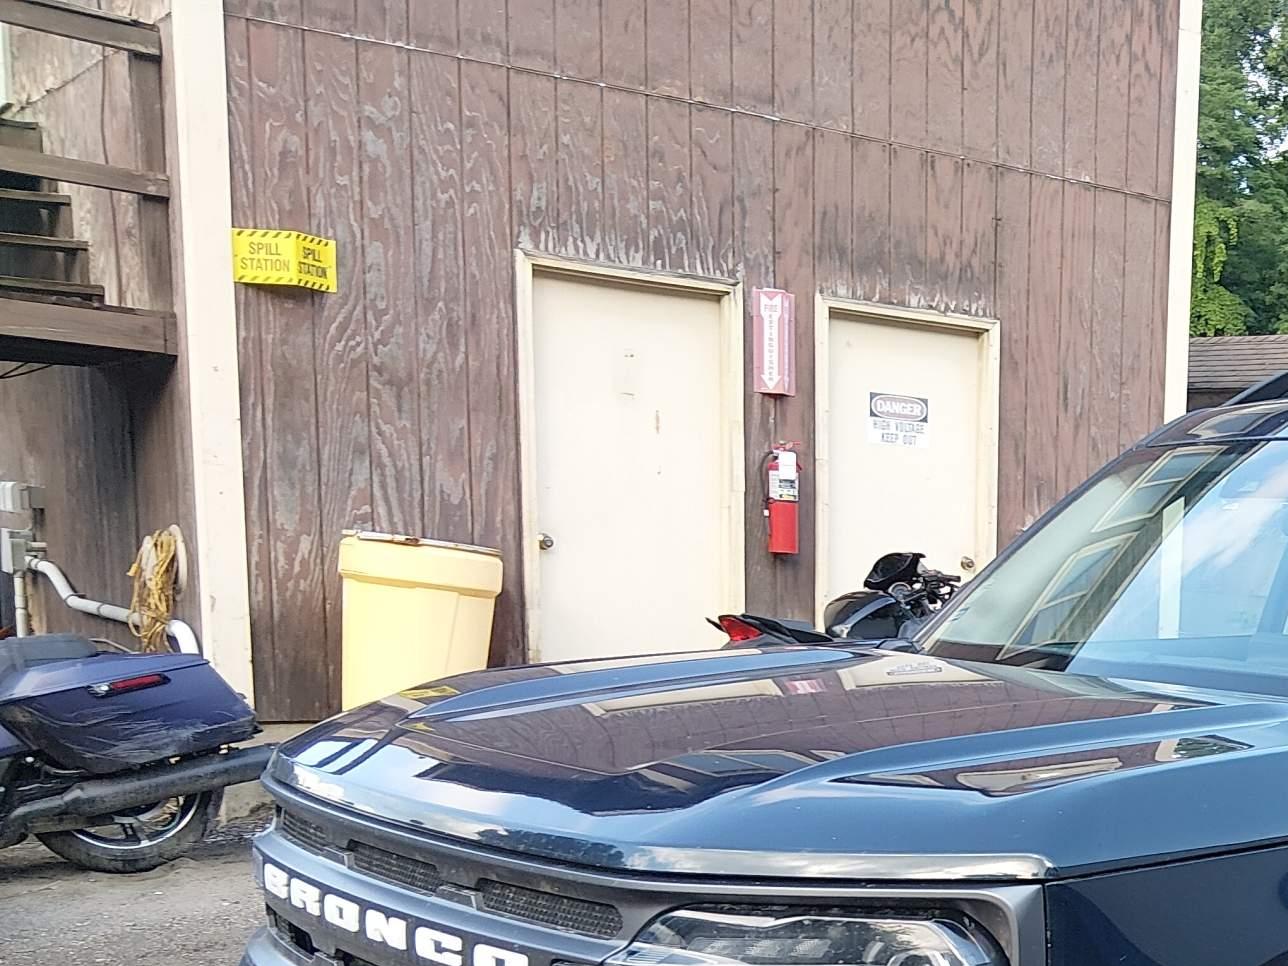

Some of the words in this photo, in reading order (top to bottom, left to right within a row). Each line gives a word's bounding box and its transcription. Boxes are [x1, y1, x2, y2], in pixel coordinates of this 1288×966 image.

[248, 241, 281, 256] SPILL
[303, 246, 322, 262] SPILL
[240, 257, 290, 272] STATION
[298, 261, 328, 279] STATION
[877, 400, 921, 417] DANGER
[873, 419, 890, 430] HIGH
[896, 422, 924, 433] VOLTAGE
[881, 432, 898, 443] KEEP
[903, 434, 917, 445] OUT
